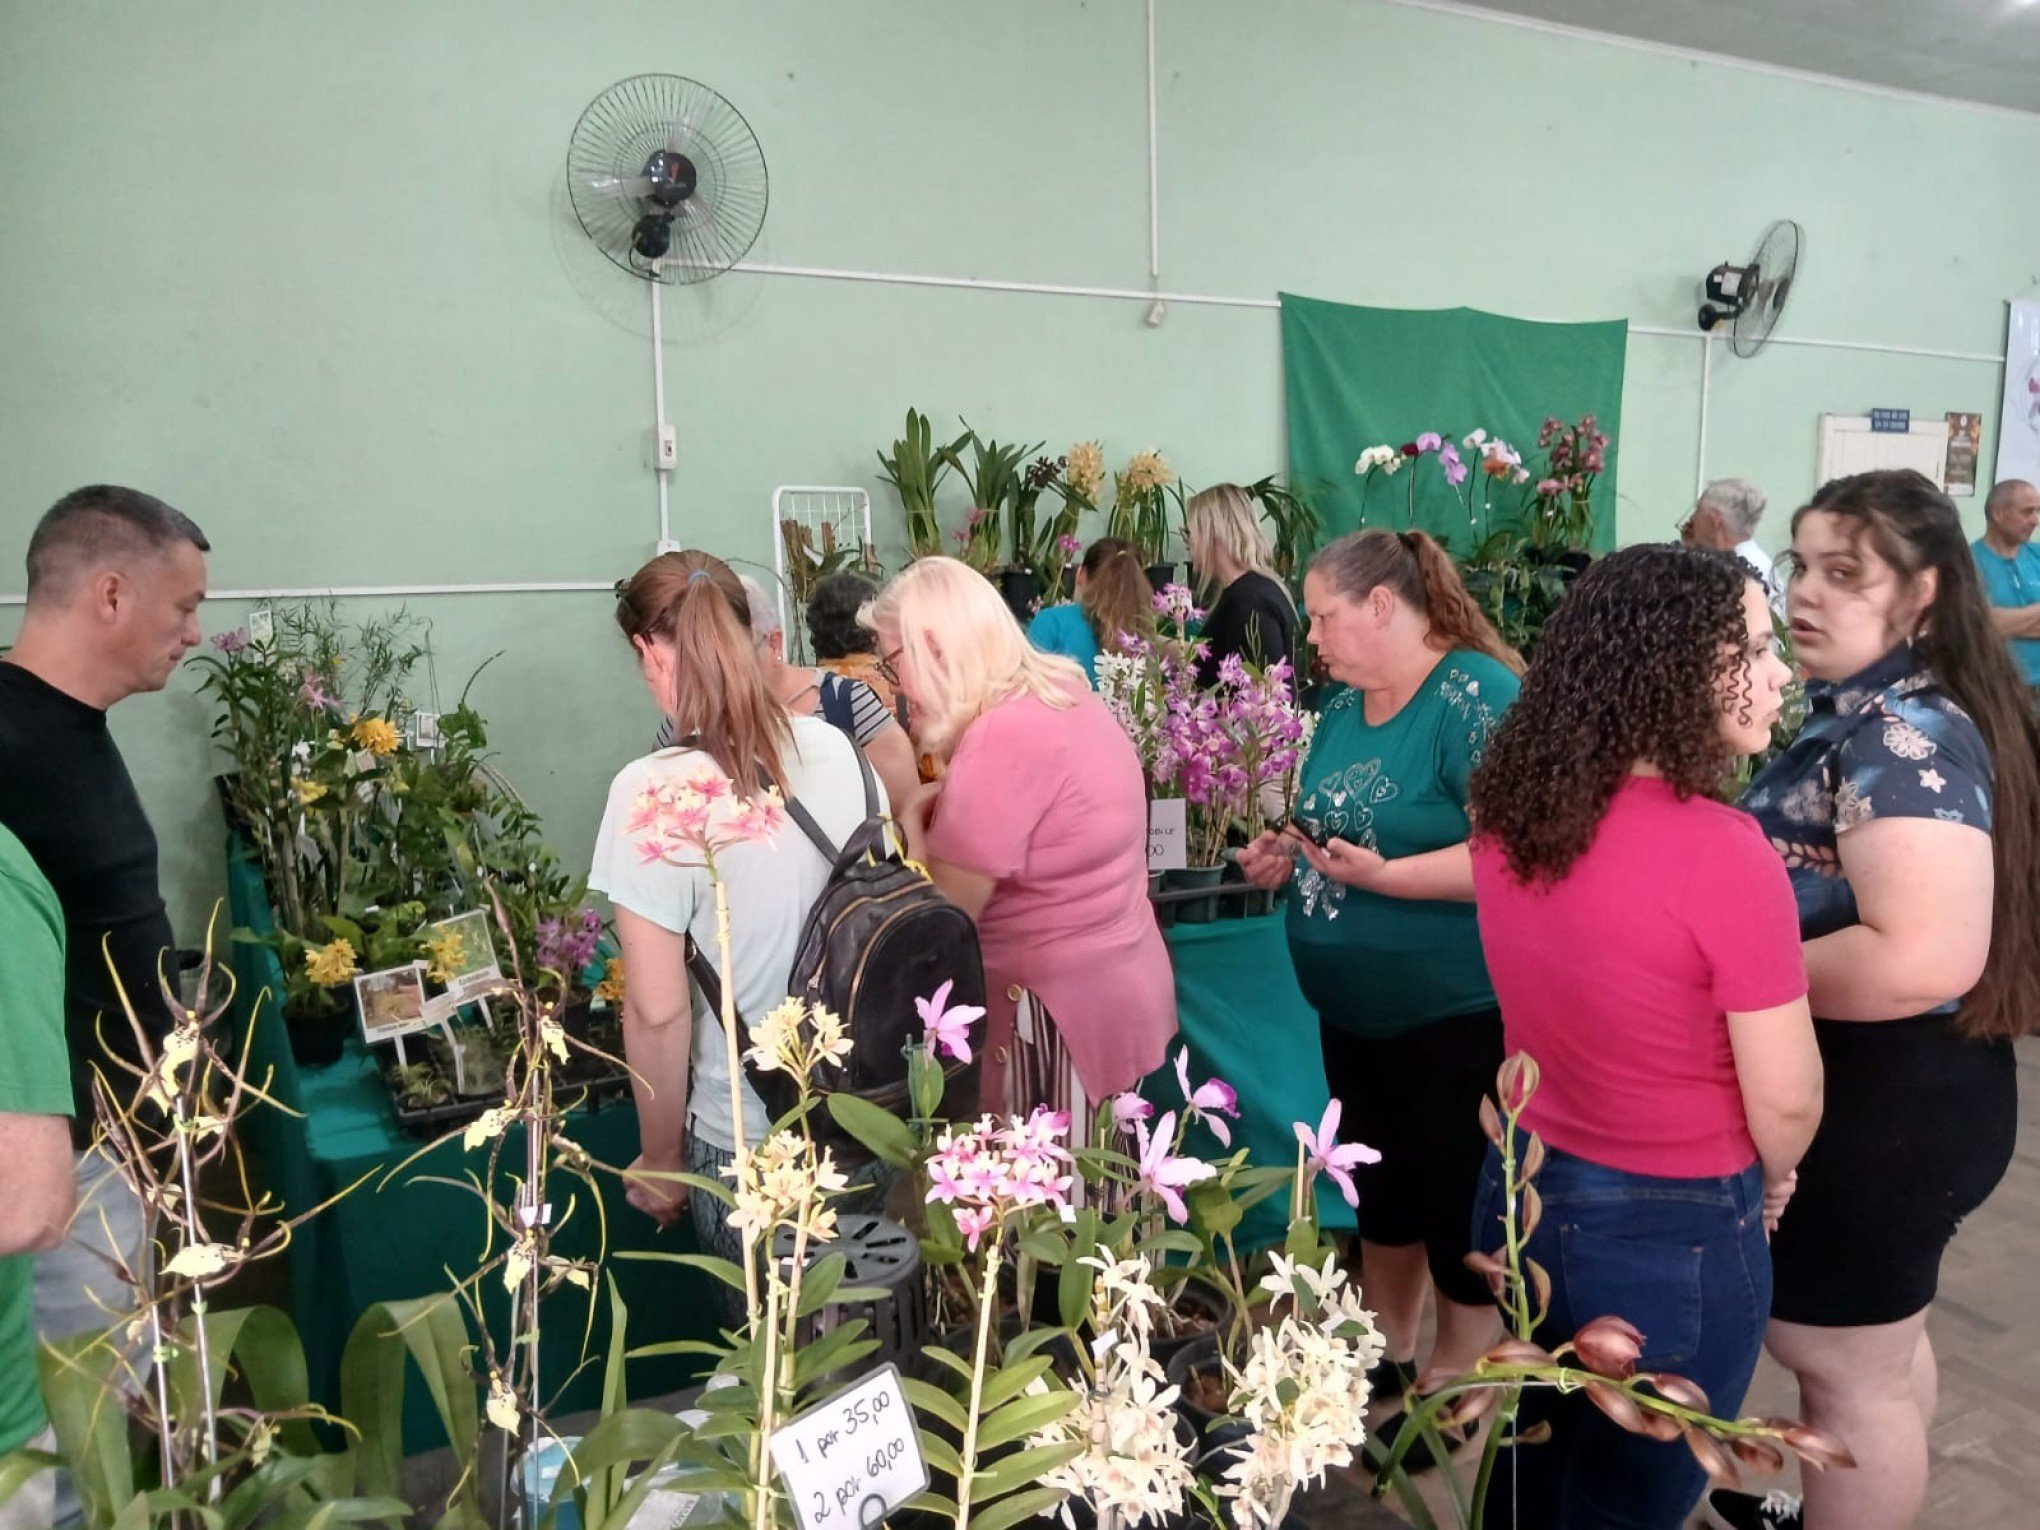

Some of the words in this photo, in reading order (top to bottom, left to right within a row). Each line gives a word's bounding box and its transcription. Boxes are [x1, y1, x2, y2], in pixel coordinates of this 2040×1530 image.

[796, 1438, 810, 1464] 1
[842, 1391, 890, 1435] 35,00
[813, 1491, 831, 1524] 2
[866, 1437, 905, 1477] 60,00
